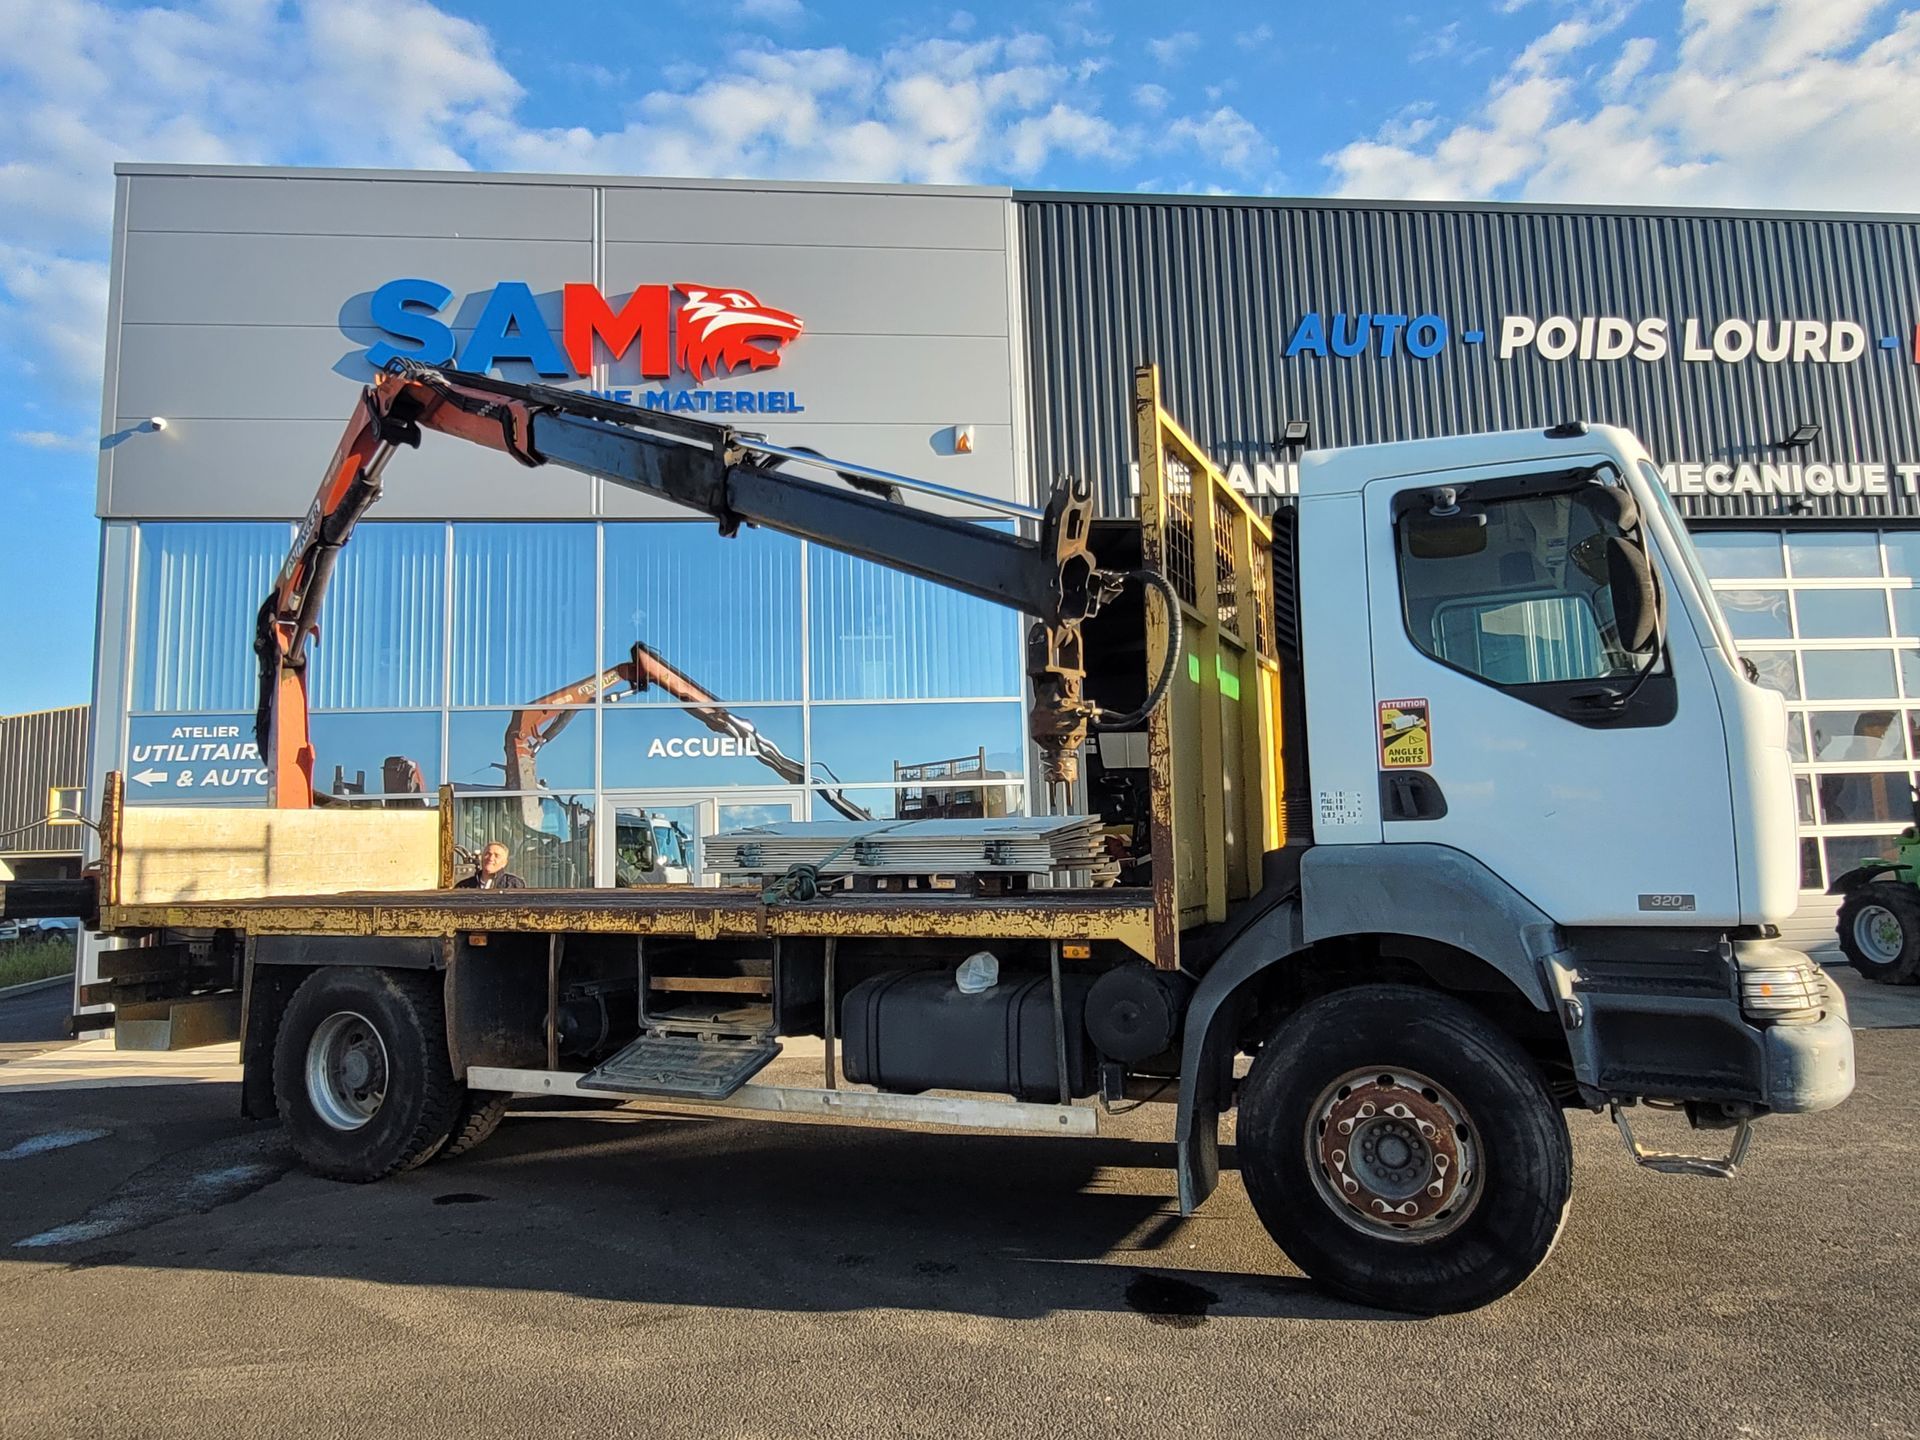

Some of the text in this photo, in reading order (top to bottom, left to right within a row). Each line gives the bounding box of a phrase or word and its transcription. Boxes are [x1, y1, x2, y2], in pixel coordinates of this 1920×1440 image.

[364, 278, 670, 378] SAM
[1286, 313, 1449, 359] AUTO
[1500, 316, 1669, 362] POIDS
[1683, 318, 1866, 363] LOURD
[646, 390, 805, 413] MATERIEL
[1381, 700, 1426, 709] ATTENTION
[171, 726, 240, 739] ATELIER
[132, 743, 262, 762] UTILITAIR
[648, 737, 760, 758] ACCUEIL
[1389, 747, 1424, 756] ANGLES
[1391, 755, 1423, 764] MORTS
[176, 770, 194, 787] &
[1651, 895, 1682, 907] 320
